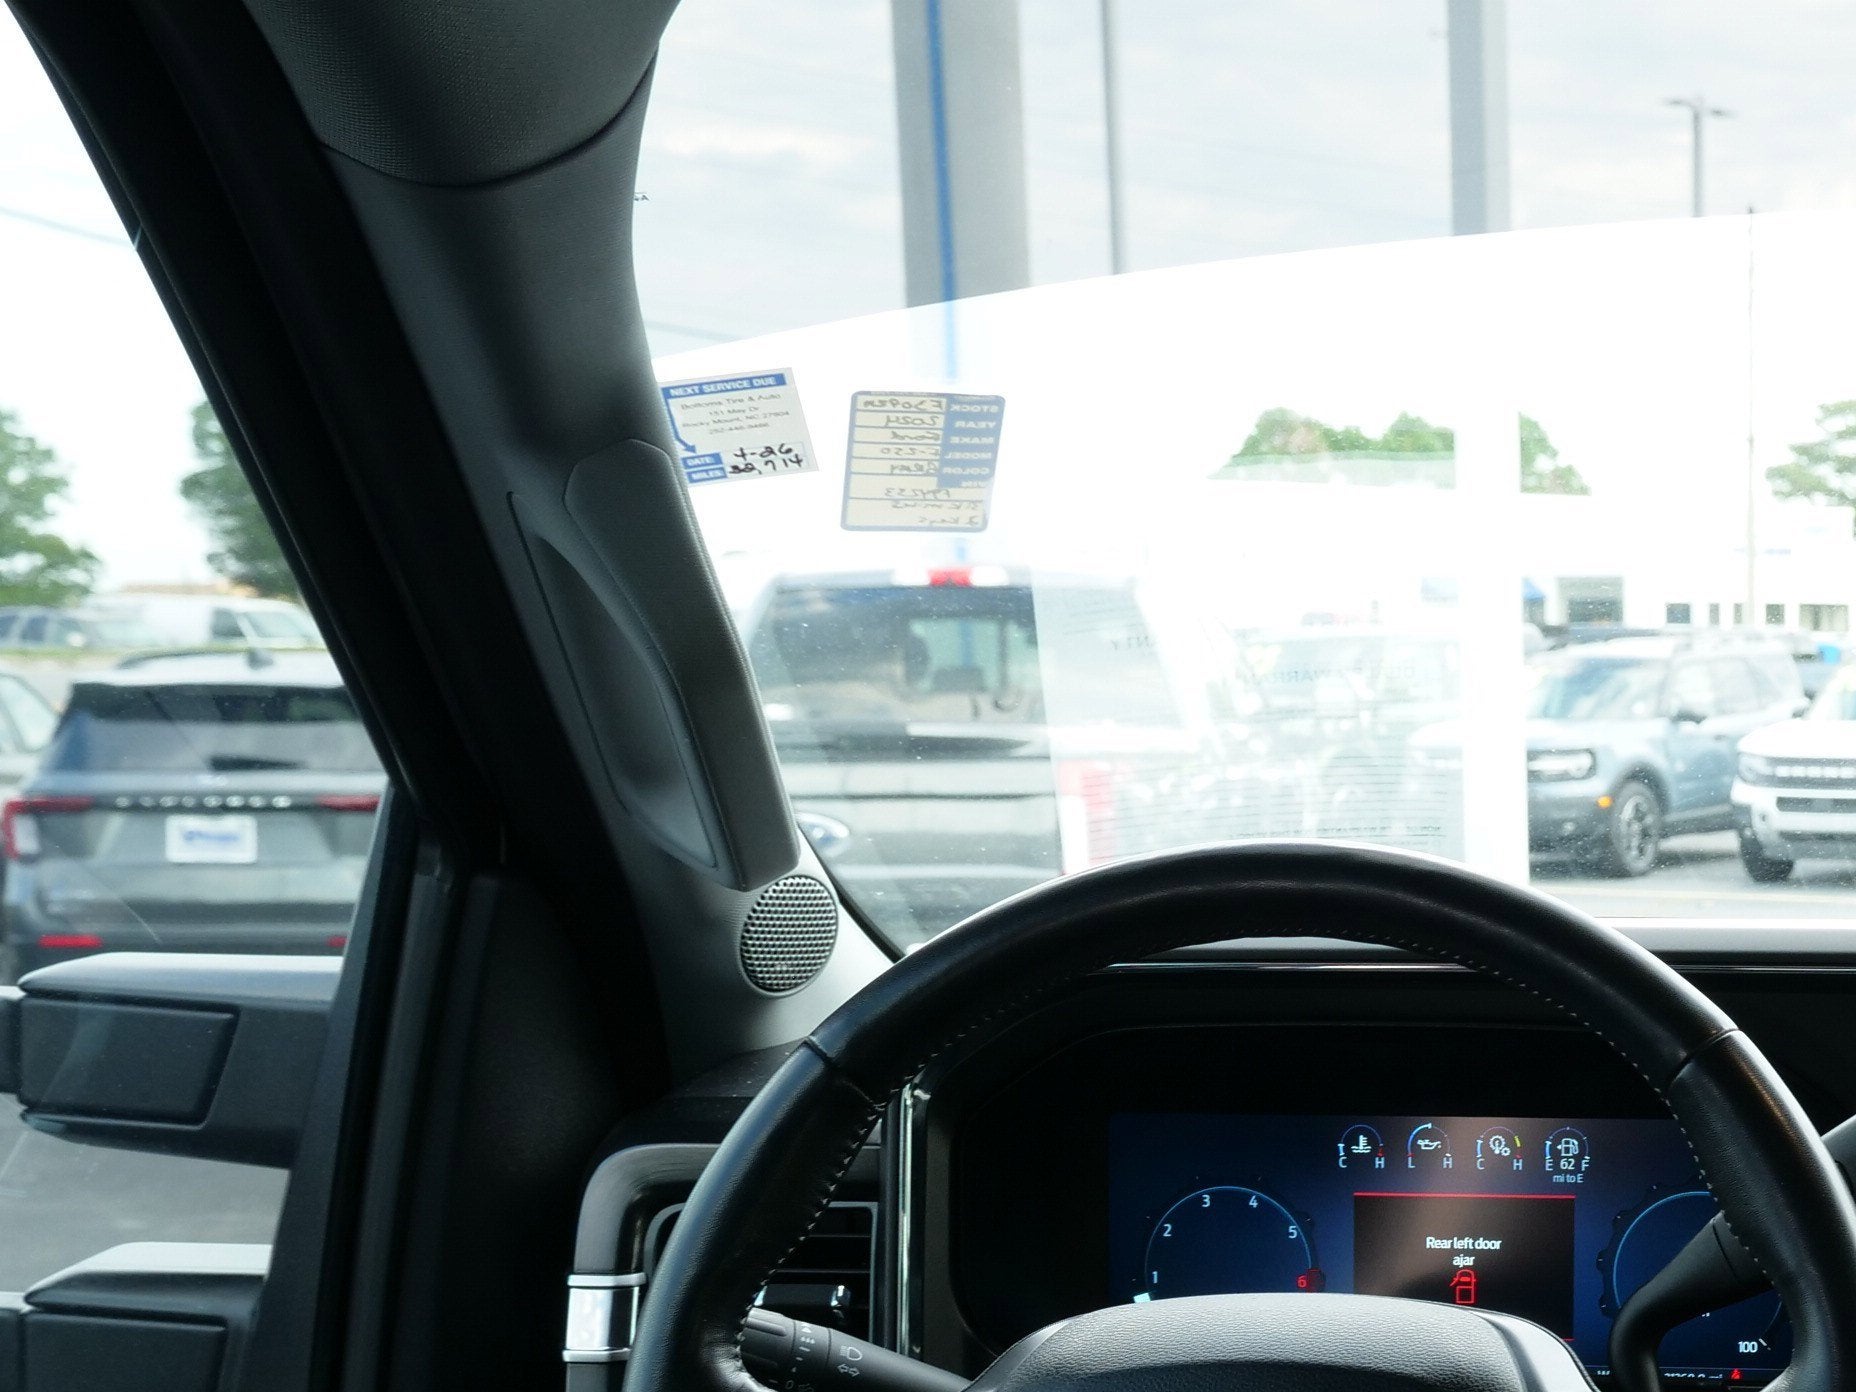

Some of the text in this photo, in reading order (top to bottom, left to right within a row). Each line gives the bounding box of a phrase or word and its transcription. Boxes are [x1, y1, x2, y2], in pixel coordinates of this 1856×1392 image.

[669, 376, 777, 397] NEXT SERVICE DUE
[1338, 1157, 1347, 1168] C
[1375, 1157, 1385, 1168] H
[1408, 1157, 1415, 1168] L
[1443, 1157, 1453, 1169] H
[1477, 1158, 1485, 1170] C
[1513, 1158, 1523, 1170] H
[1545, 1159, 1553, 1171] E
[1560, 1158, 1575, 1169] 62
[1581, 1160, 1589, 1172] F
[1553, 1174, 1584, 1182] mi to E
[1202, 1194, 1210, 1207] 3
[1249, 1195, 1258, 1208] 4
[1163, 1224, 1172, 1237] 2
[1288, 1225, 1297, 1239] 5
[1425, 1236, 1502, 1250] Rear left door
[1452, 1253, 1475, 1268] ajar
[1152, 1271, 1158, 1284] 1
[1297, 1275, 1307, 1288] 6
[1737, 1341, 1758, 1354] 100
